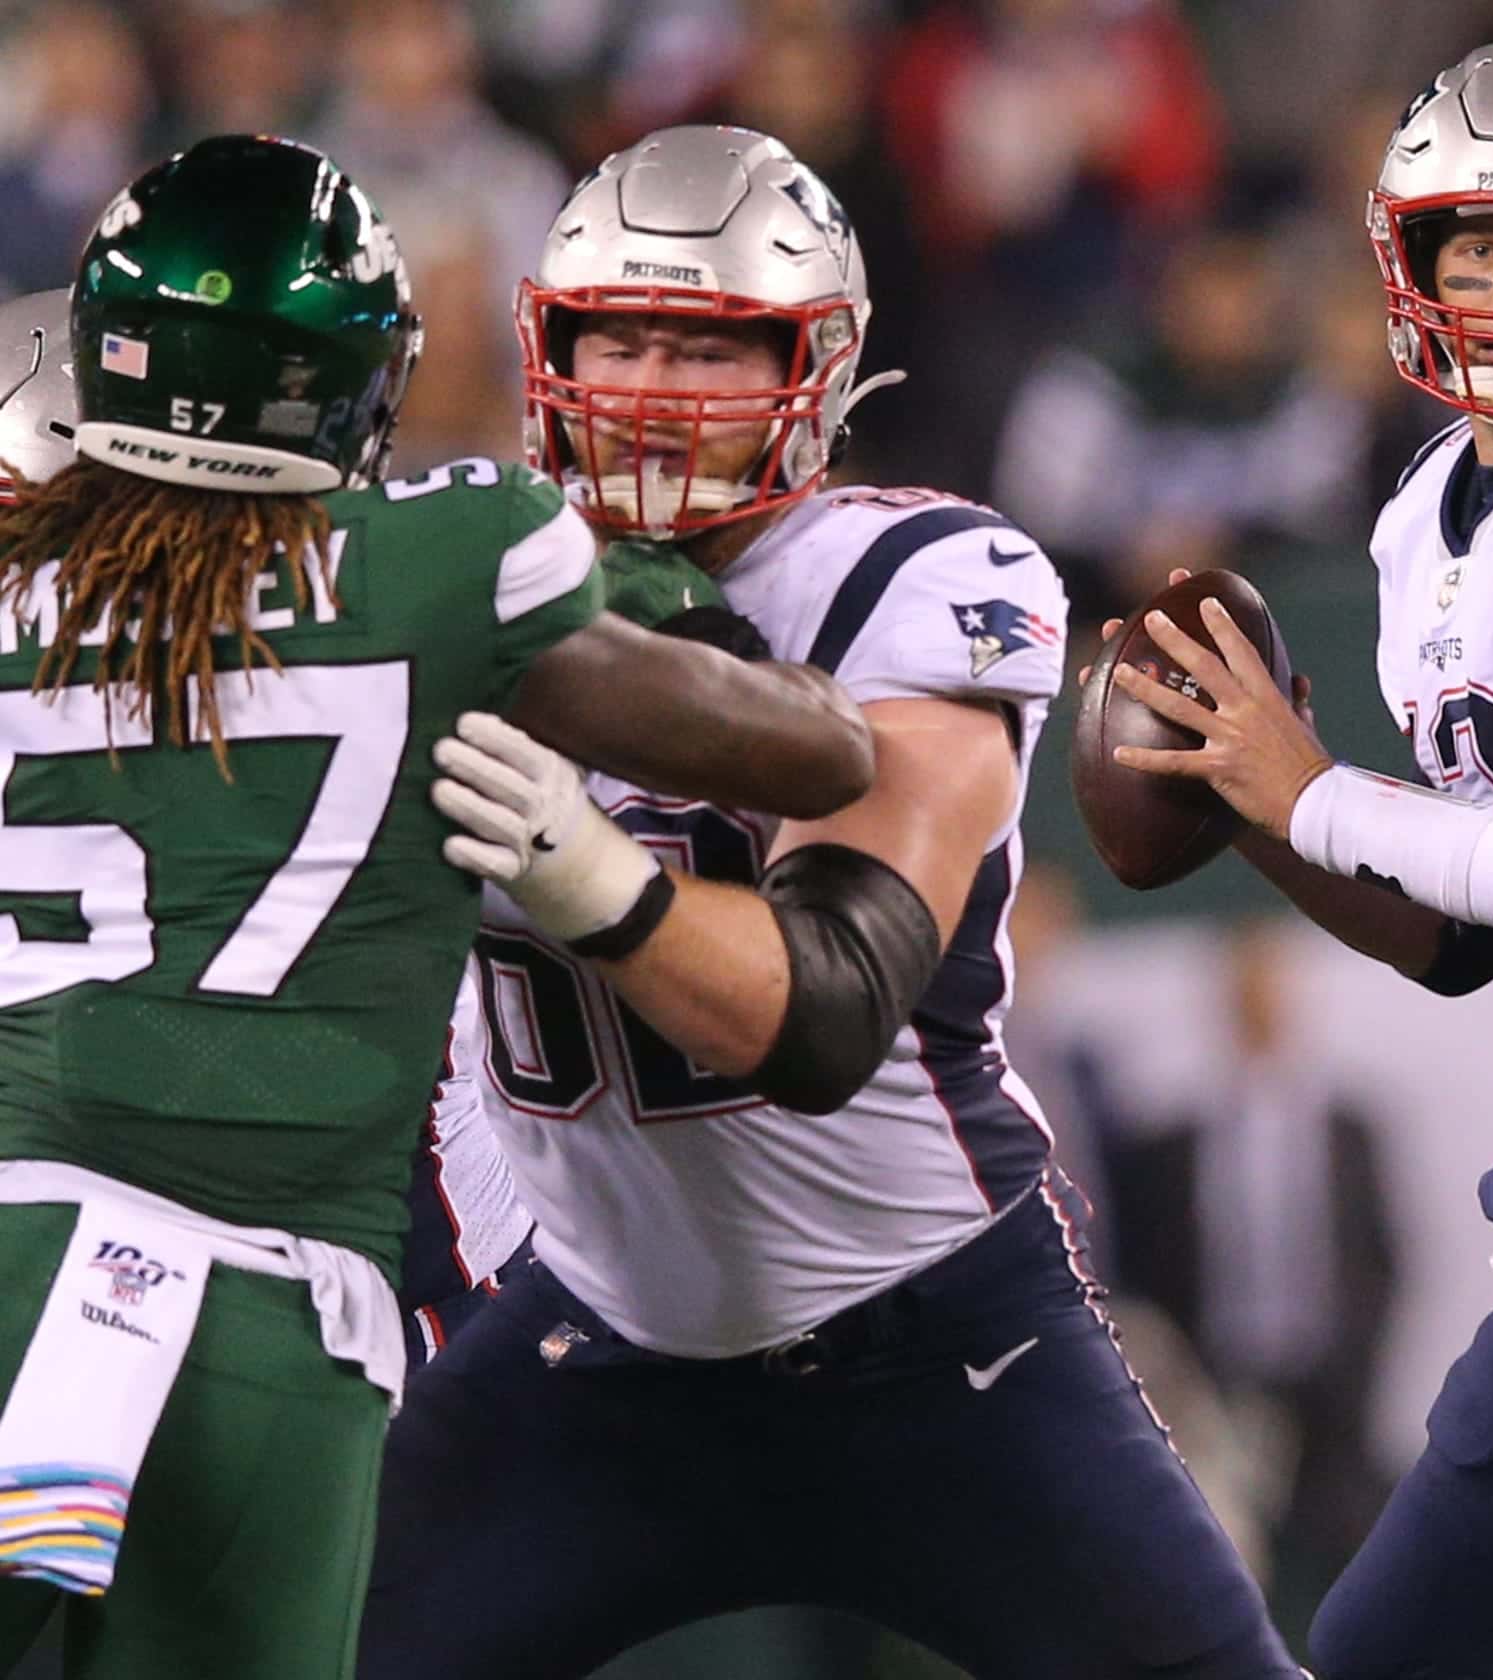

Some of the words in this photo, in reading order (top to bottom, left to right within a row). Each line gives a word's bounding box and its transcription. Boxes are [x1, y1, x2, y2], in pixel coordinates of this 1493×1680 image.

[622, 259, 702, 286] PATRIOTS
[168, 397, 226, 434] 57
[108, 438, 178, 463] NEW
[186, 454, 285, 479] YORK
[0, 661, 410, 1010] 57
